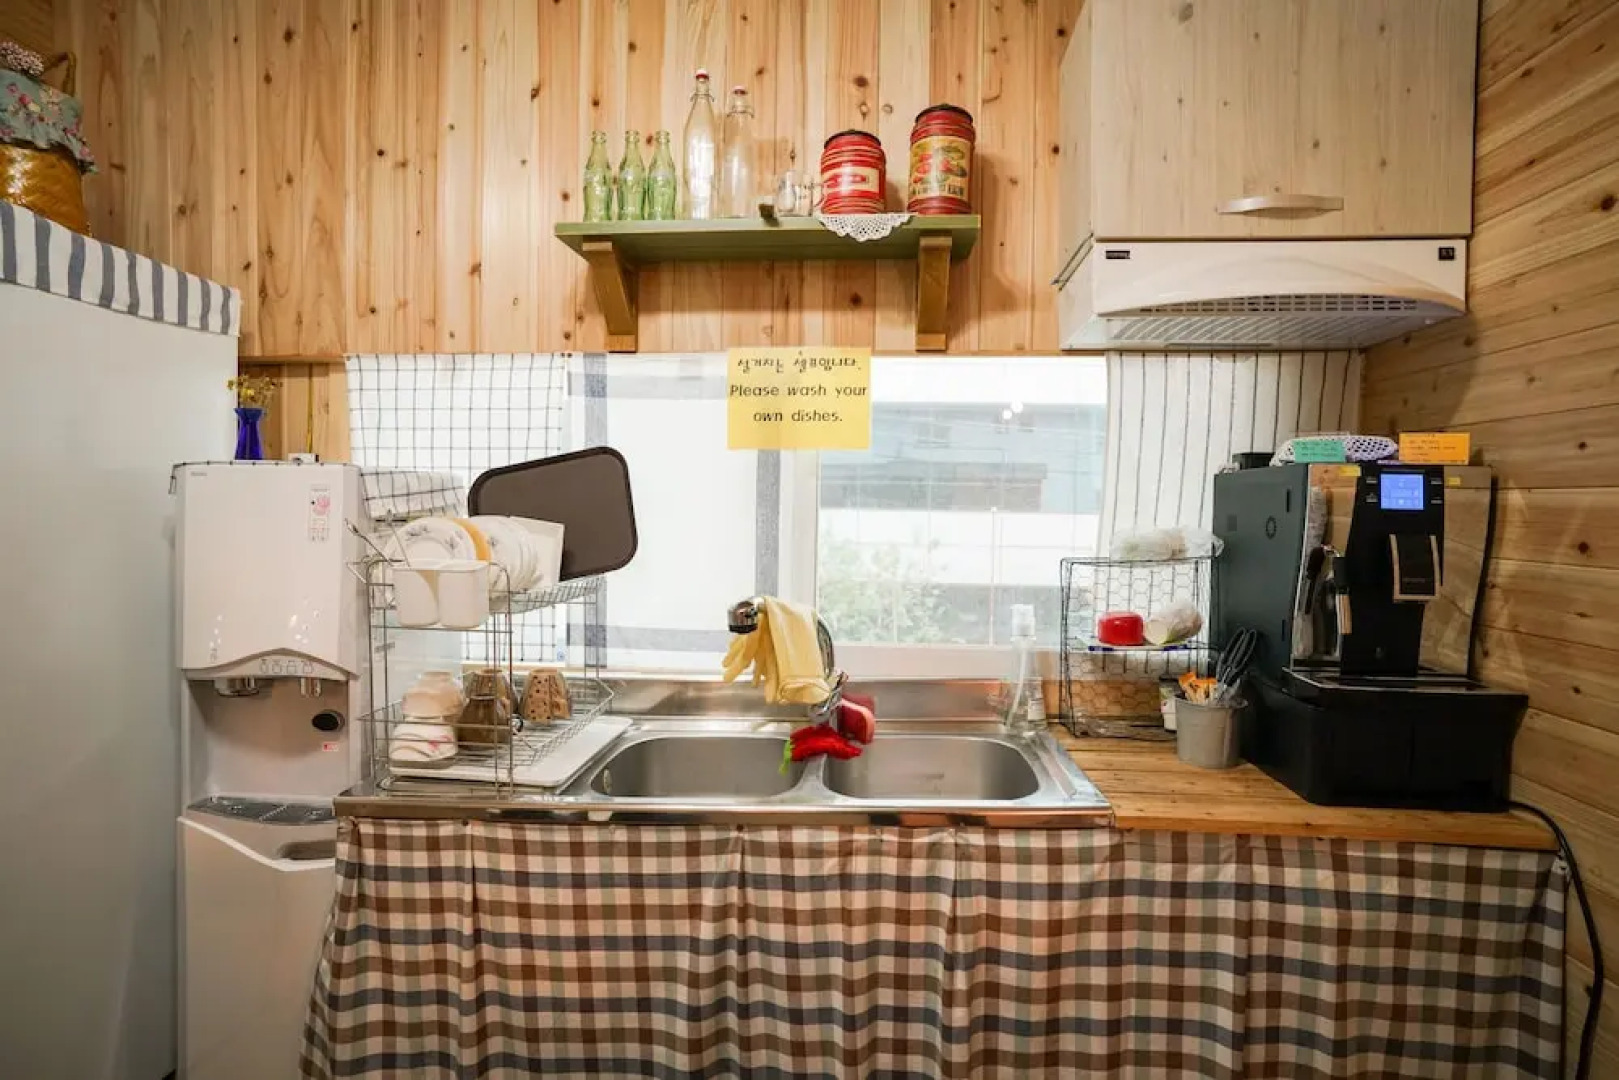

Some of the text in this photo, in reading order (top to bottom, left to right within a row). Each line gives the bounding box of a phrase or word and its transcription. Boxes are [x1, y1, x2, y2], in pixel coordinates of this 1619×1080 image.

[737, 356, 785, 374] 설거지는
[729, 384, 868, 399] Please wash your
[753, 409, 843, 422] own dishes.
